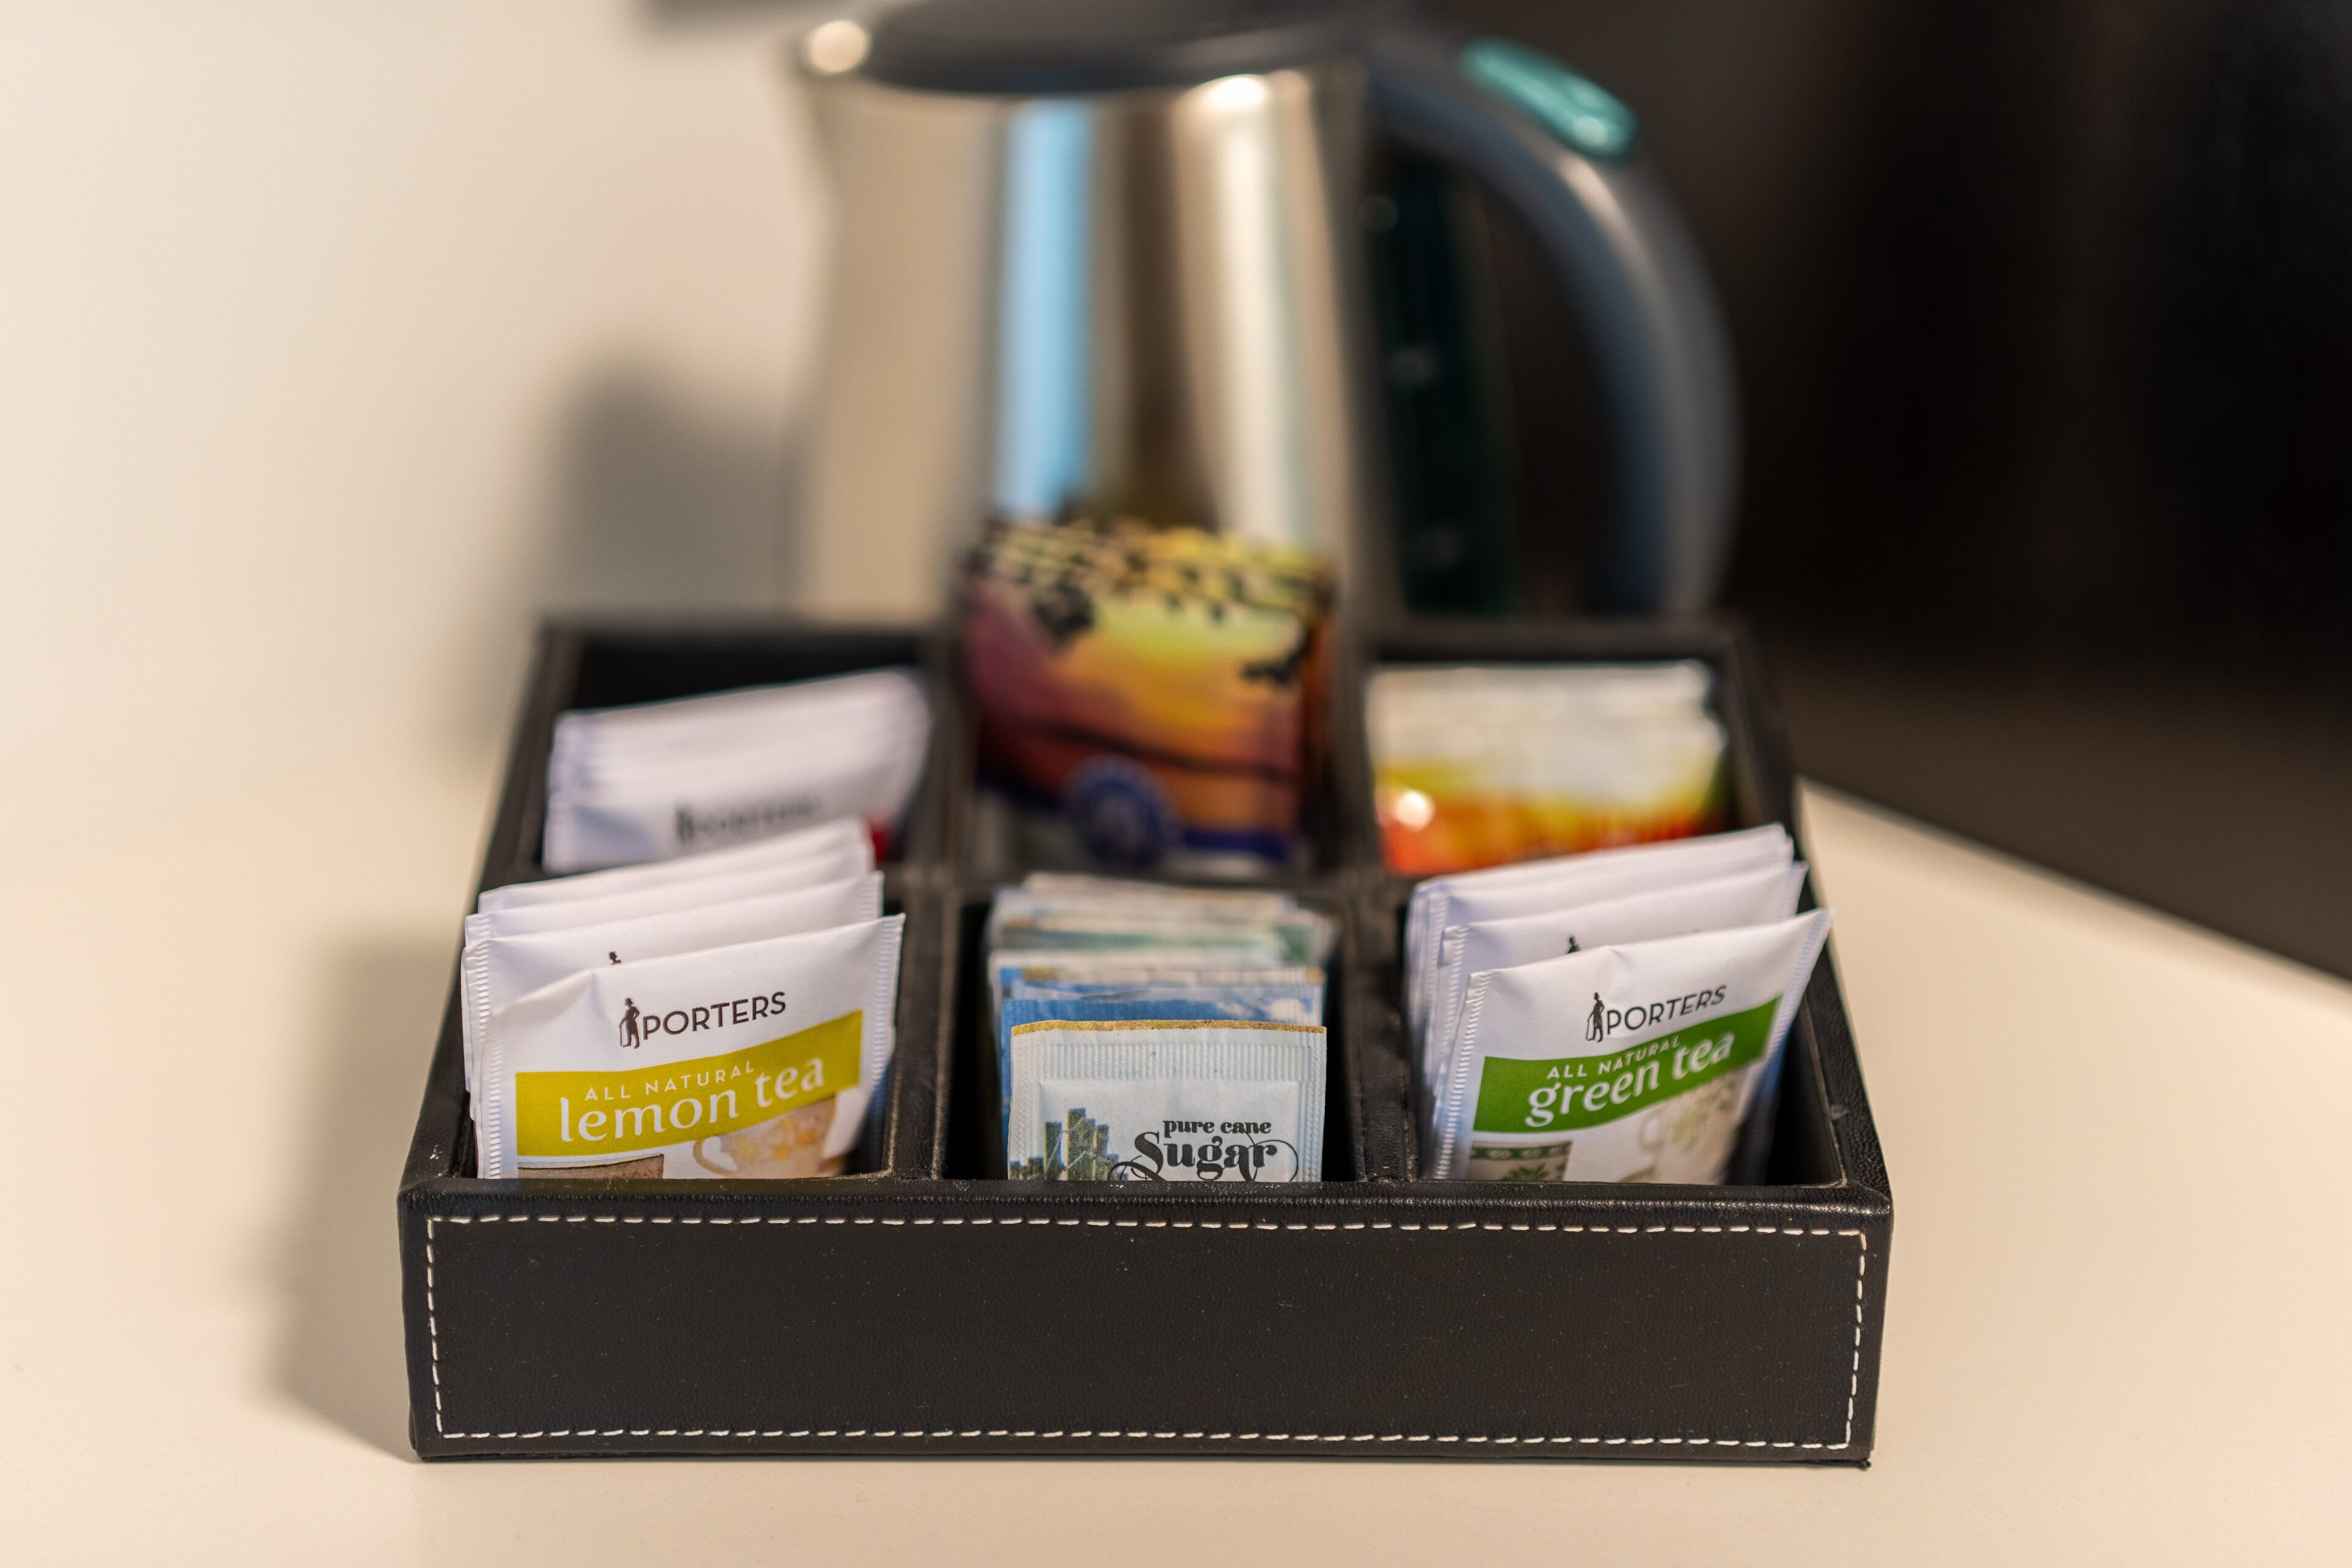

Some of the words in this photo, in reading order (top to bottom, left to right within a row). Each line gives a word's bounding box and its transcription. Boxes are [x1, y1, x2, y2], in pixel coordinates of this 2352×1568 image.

[643, 992, 786, 1040] PORTERS
[1607, 985, 1727, 1035] PORTERS
[585, 1085, 631, 1101] ALL
[646, 1060, 755, 1096] NATURAL
[1525, 1060, 1659, 1128] green
[1672, 1033, 1735, 1080] tea
[1547, 1064, 1588, 1080] ALL
[1598, 1035, 1680, 1075] NATURAL
[560, 1088, 739, 1142] lemon
[755, 1058, 824, 1107] tea
[1163, 1119, 1214, 1138] pure
[1221, 1119, 1271, 1134] cane
[1108, 1131, 1298, 1182] Sugar
